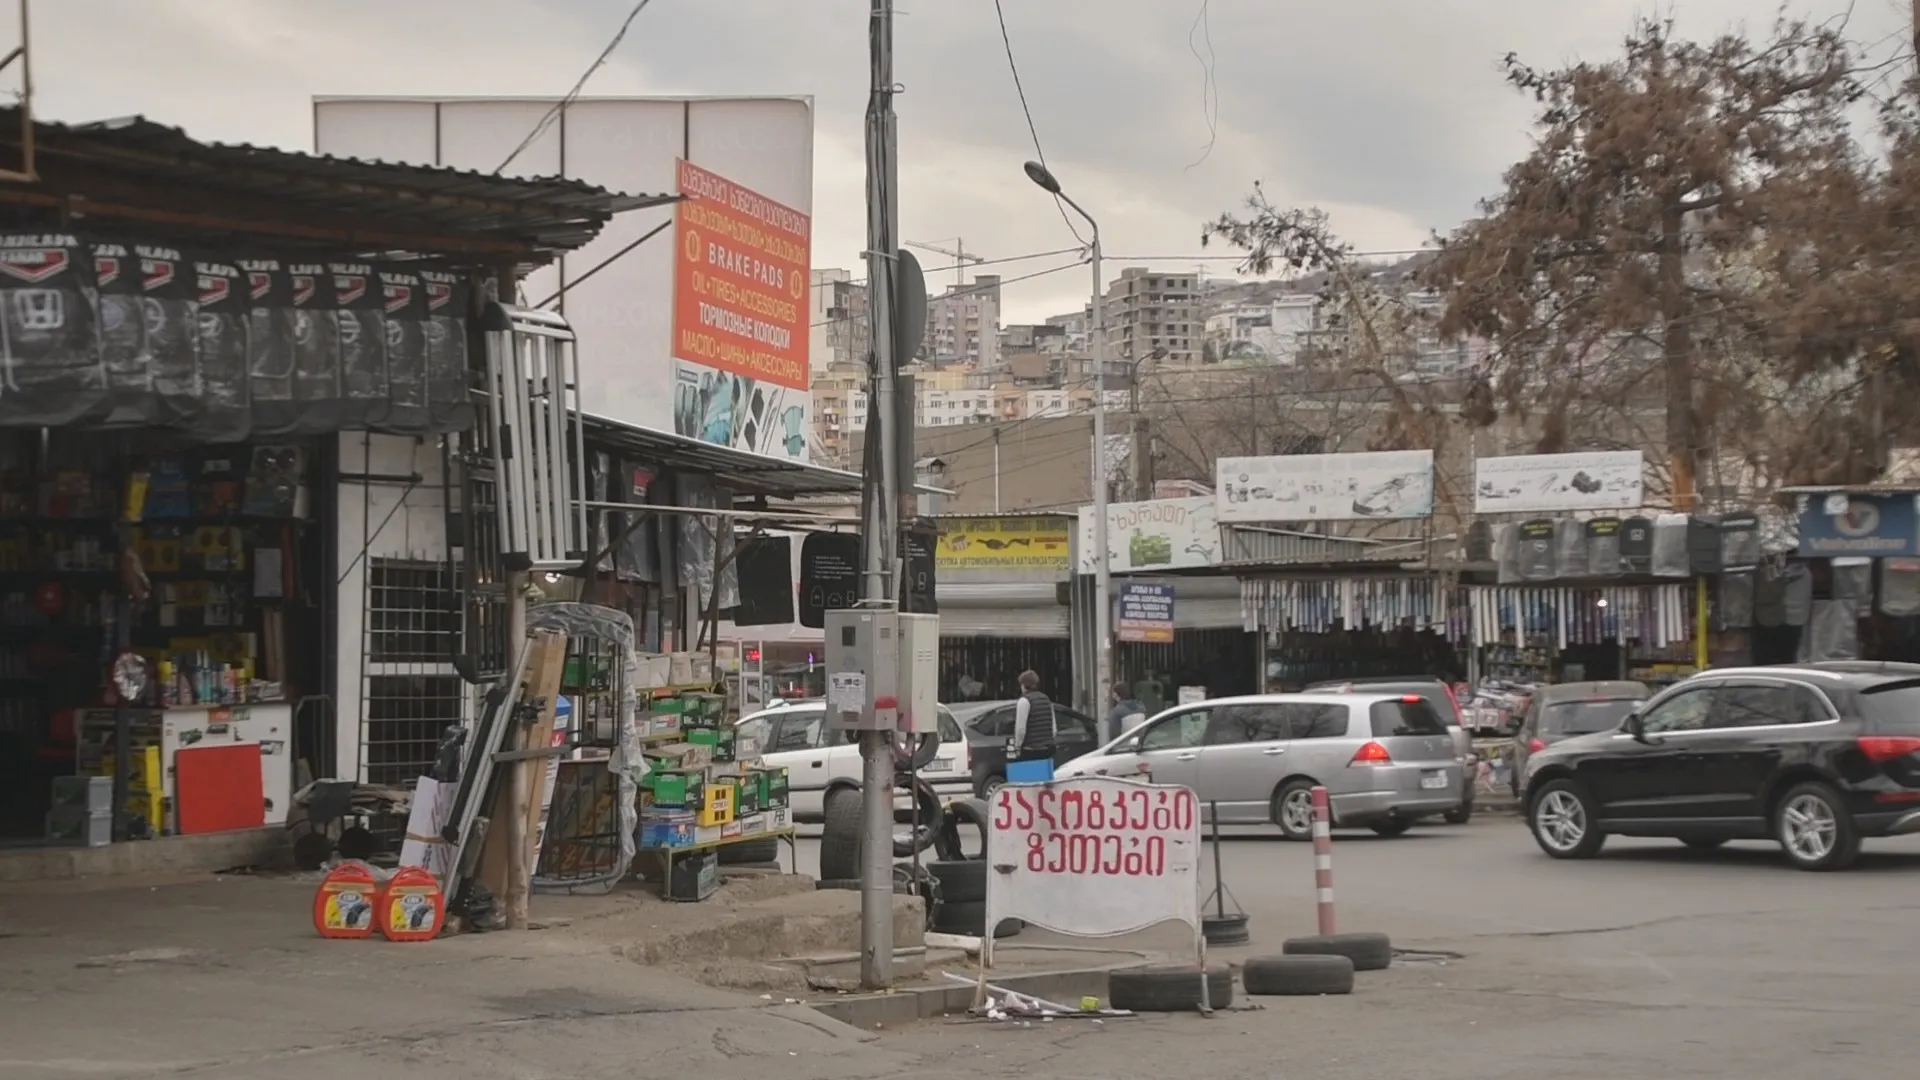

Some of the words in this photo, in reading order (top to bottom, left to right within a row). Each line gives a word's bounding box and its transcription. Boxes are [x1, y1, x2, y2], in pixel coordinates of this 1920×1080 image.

[708, 242, 751, 277] BRAKE
[753, 260, 784, 289] PADS
[692, 270, 707, 294] OIL
[711, 276, 737, 304] TIRES
[740, 288, 797, 324] ACCESSORIES
[699, 301, 753, 339] ТОРМОЗНЫЕ
[754, 319, 791, 351] КОЛОДКИ
[682, 329, 716, 359] МАСЛО
[720, 342, 746, 365] ШИНЫ
[750, 350, 803, 381] АКСЕССУАРЫ
[1116, 504, 1186, 530] ხარატი
[1026, 832, 1166, 877] ზეთები
